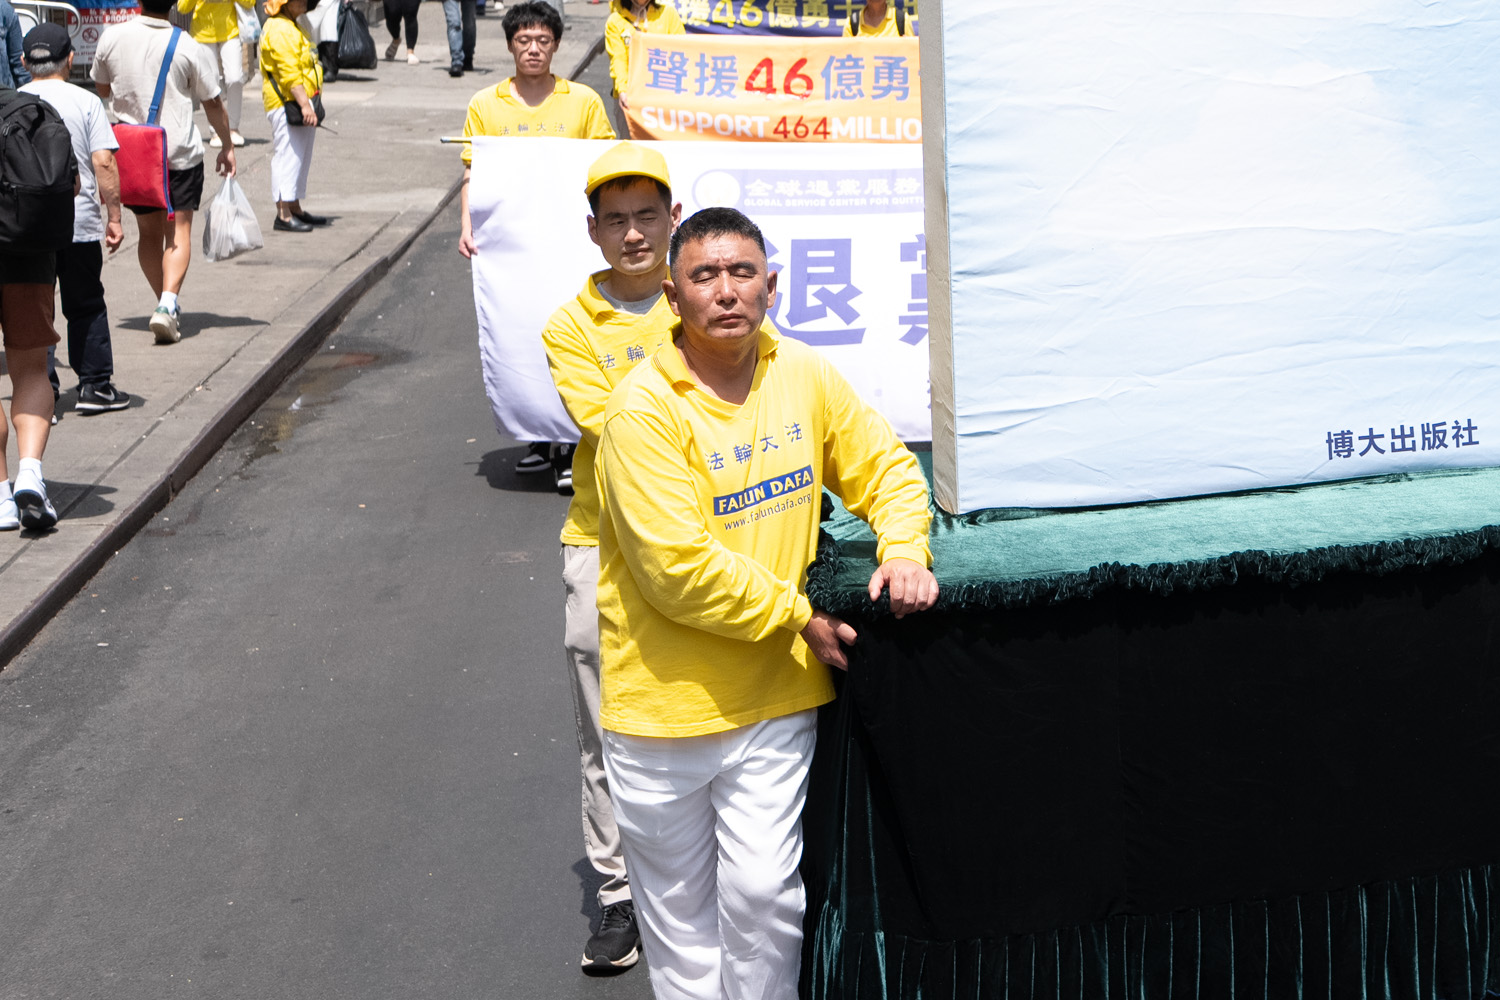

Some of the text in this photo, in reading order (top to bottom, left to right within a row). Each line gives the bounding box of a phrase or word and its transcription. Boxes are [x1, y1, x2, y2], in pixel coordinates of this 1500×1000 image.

[500, 122, 565, 136] 法輪大法
[640, 107, 769, 138] SUPPORT
[744, 178, 921, 198] 全球退黨服務
[744, 199, 783, 207] GLOBAL
[785, 198, 826, 207] SERVICE
[829, 198, 866, 207] CENTER
[870, 197, 889, 205] FOR
[598, 343, 664, 370] 法輪
[704, 421, 803, 472] 法輪大法
[1325, 418, 1480, 461] 博大出版社
[718, 469, 813, 515] FALUN DAFA
[723, 492, 812, 531] www.falundafa.org
